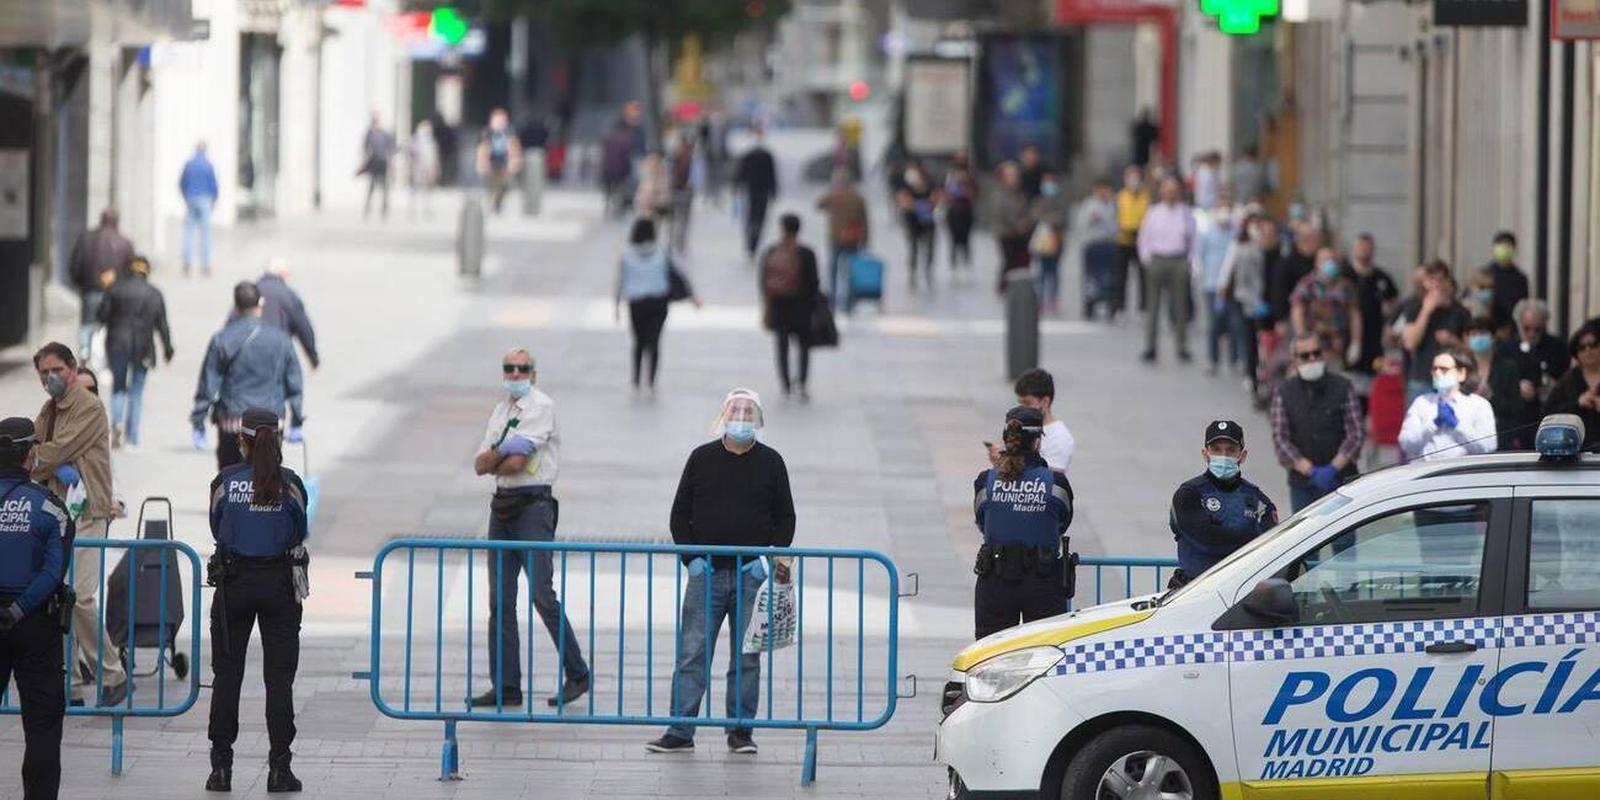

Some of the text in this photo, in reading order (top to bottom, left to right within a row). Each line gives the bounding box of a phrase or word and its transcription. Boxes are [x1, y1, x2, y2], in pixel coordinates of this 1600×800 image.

[229, 480, 257, 493] POL
[992, 478, 1046, 493] POLICÍA
[992, 492, 1046, 504] MUNICIPAL
[249, 501, 282, 512] Madrid
[1013, 503, 1046, 512] Madrid
[1261, 648, 1600, 725] POLICÍA
[1263, 721, 1491, 758] MUNICIPAL
[1260, 757, 1374, 779] MADRID
